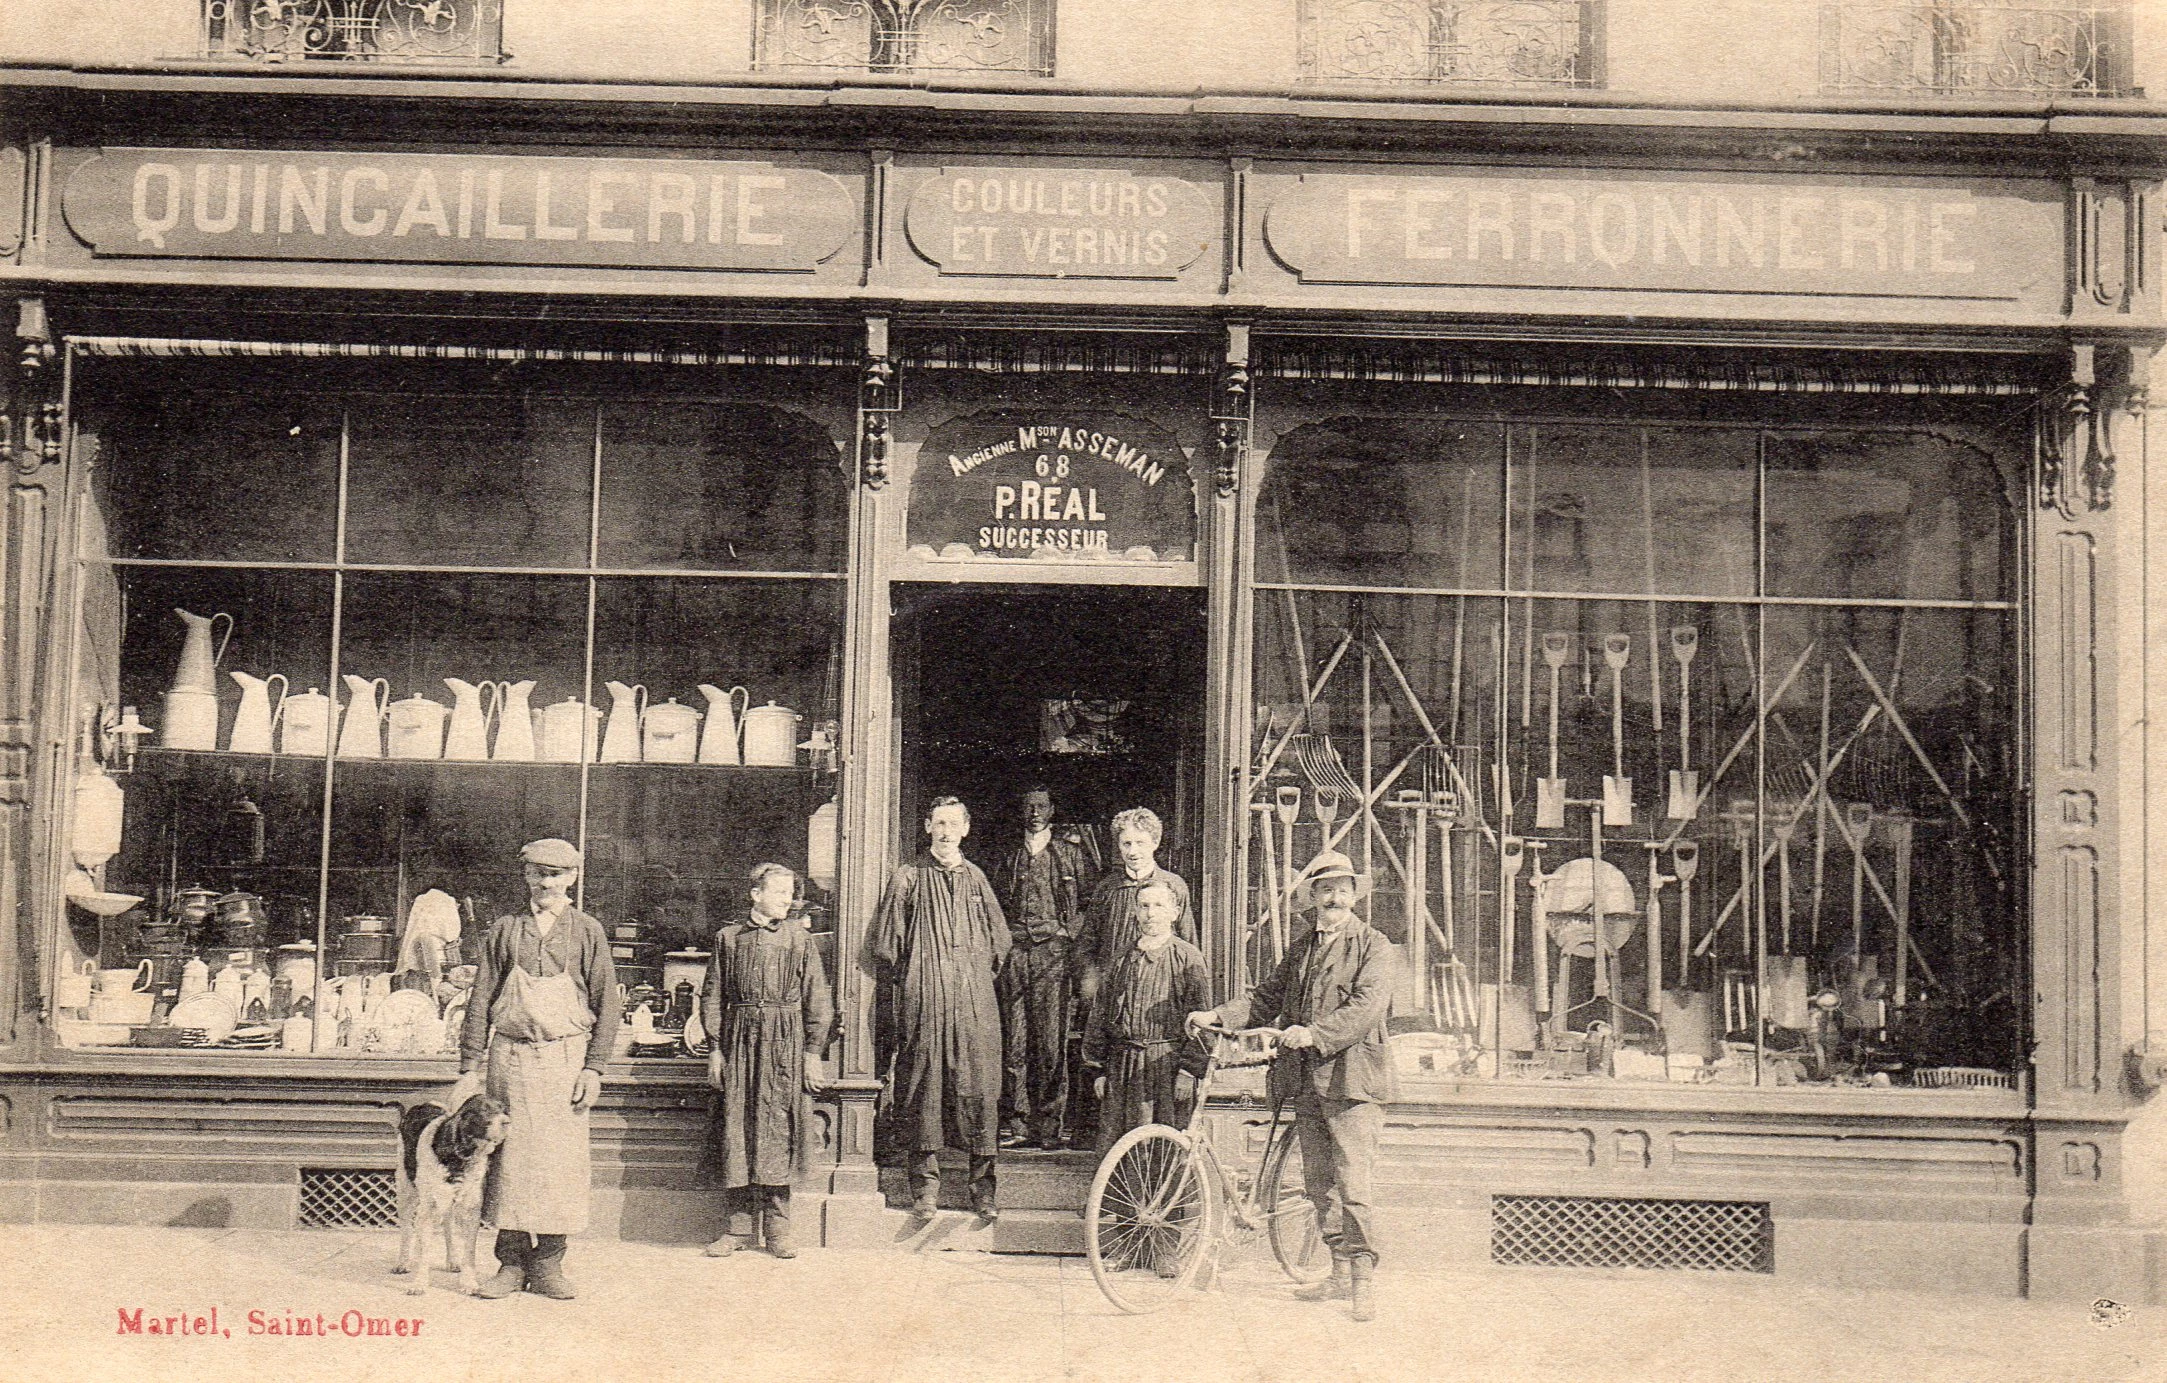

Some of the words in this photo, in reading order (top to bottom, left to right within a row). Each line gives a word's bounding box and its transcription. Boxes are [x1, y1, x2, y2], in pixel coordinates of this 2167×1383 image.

[131, 162, 785, 247] QUINCAILLERIE
[952, 176, 1169, 218] COULEURS
[952, 226, 999, 262] ET
[1020, 227, 1169, 265] VERNIS
[1345, 186, 1977, 273] FERRONNERIE
[1035, 454, 1070, 478] 68
[1057, 426, 1164, 486] ASSEMAN
[979, 526, 1108, 550] SUCCESSEUR
